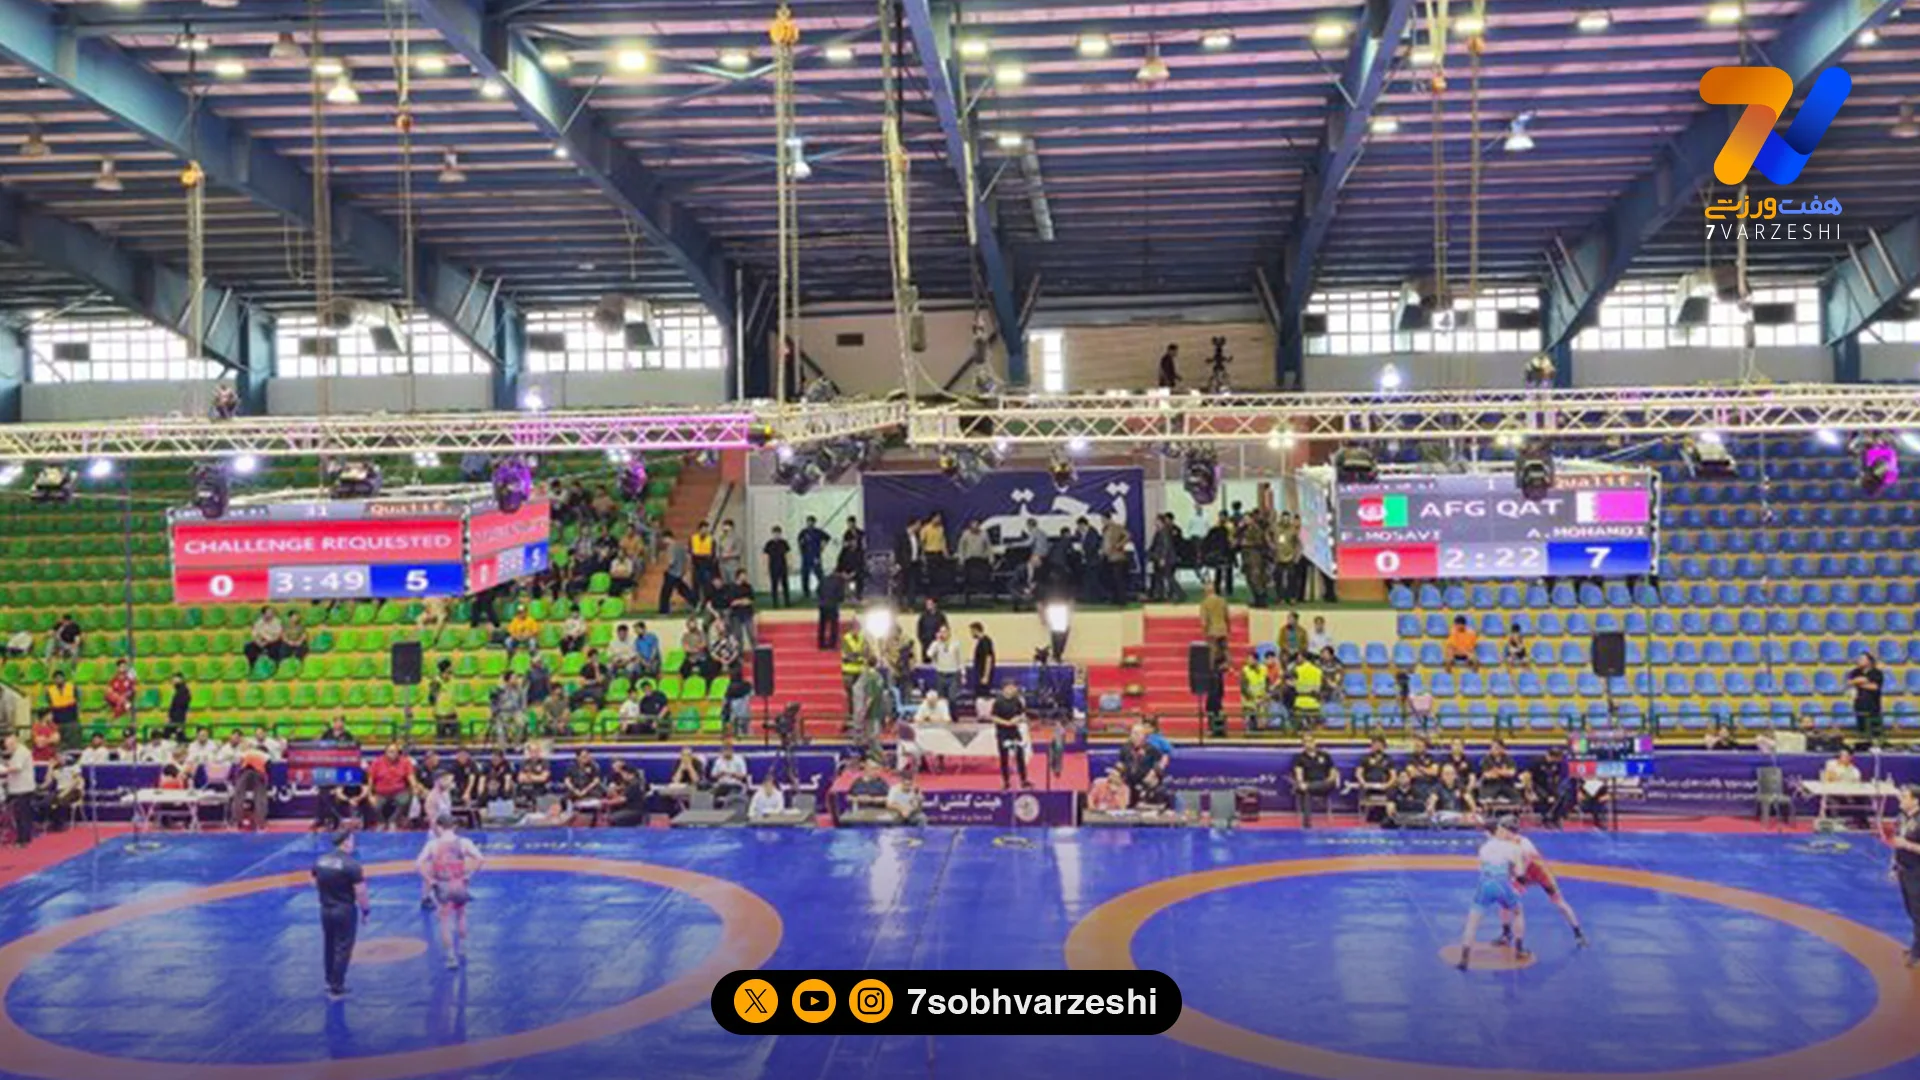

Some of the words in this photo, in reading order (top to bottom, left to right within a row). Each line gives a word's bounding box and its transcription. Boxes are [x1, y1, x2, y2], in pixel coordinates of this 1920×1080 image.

[1420, 500, 1486, 517] AFG
[1496, 499, 1564, 518] QAT
[184, 537, 314, 555] CHALLENGE
[321, 535, 452, 551] REQUESTED
[1375, 550, 1401, 573] 0
[1444, 547, 1541, 569] 2:22
[1585, 547, 1611, 569] 7
[209, 574, 234, 597] 0
[275, 571, 364, 593] 3:49
[406, 569, 429, 592] 5
